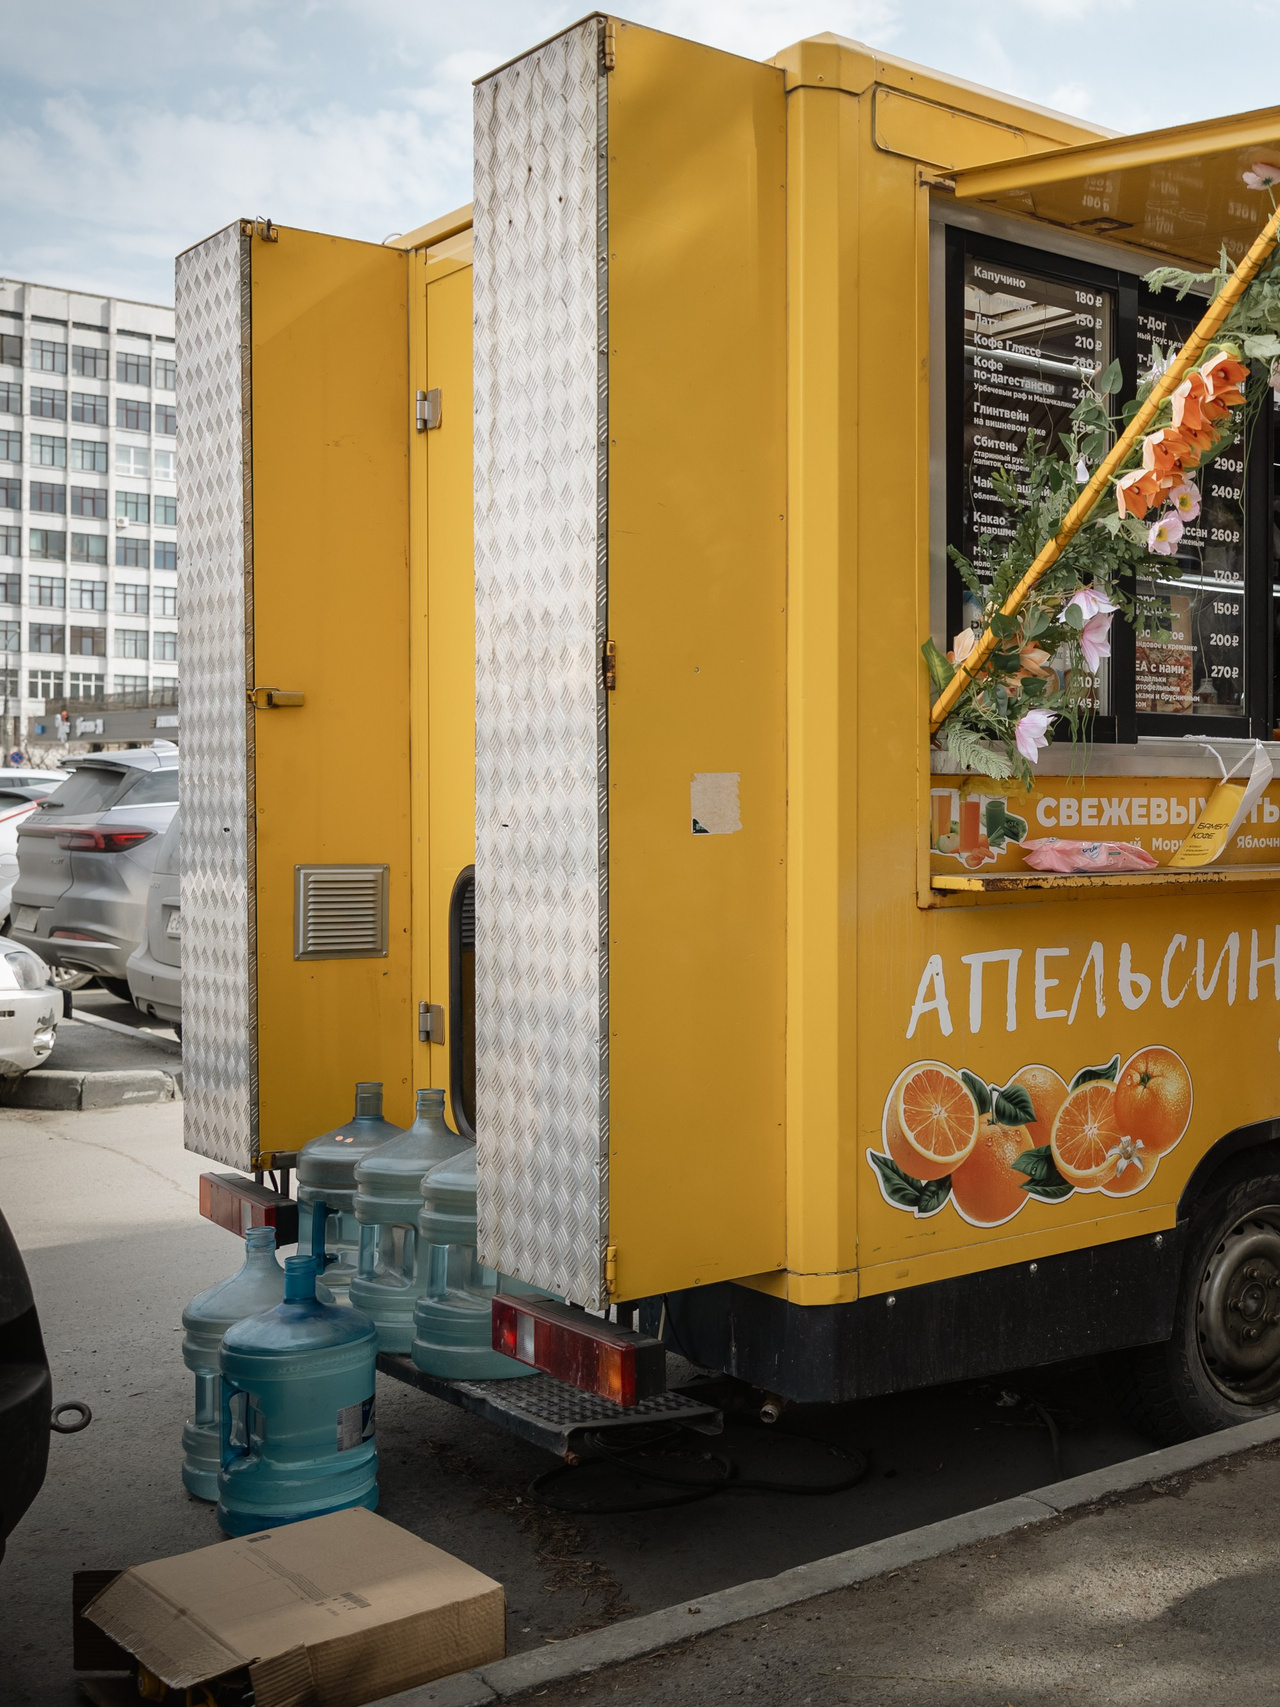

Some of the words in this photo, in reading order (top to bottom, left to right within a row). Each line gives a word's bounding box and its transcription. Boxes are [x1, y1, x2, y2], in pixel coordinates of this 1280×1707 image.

[974, 266, 1026, 289] Капучино
[973, 333, 1004, 350] Кофе
[1005, 341, 1042, 358] Гляссе
[973, 355, 1004, 371] Кофе
[973, 369, 1055, 394] по-дагестански
[1013, 392, 1028, 401] раф
[973, 402, 1030, 422] Глинтвейн
[973, 417, 984, 426] на
[985, 419, 1027, 434] вишневом
[1028, 427, 1047, 437] оке
[973, 435, 1019, 452] Сбитень
[973, 450, 1011, 462] старинный
[973, 512, 1006, 525] Какао
[980, 526, 1018, 537] маршме
[1159, 664, 1185, 674] нами
[1191, 832, 1216, 840] КОФЕ
